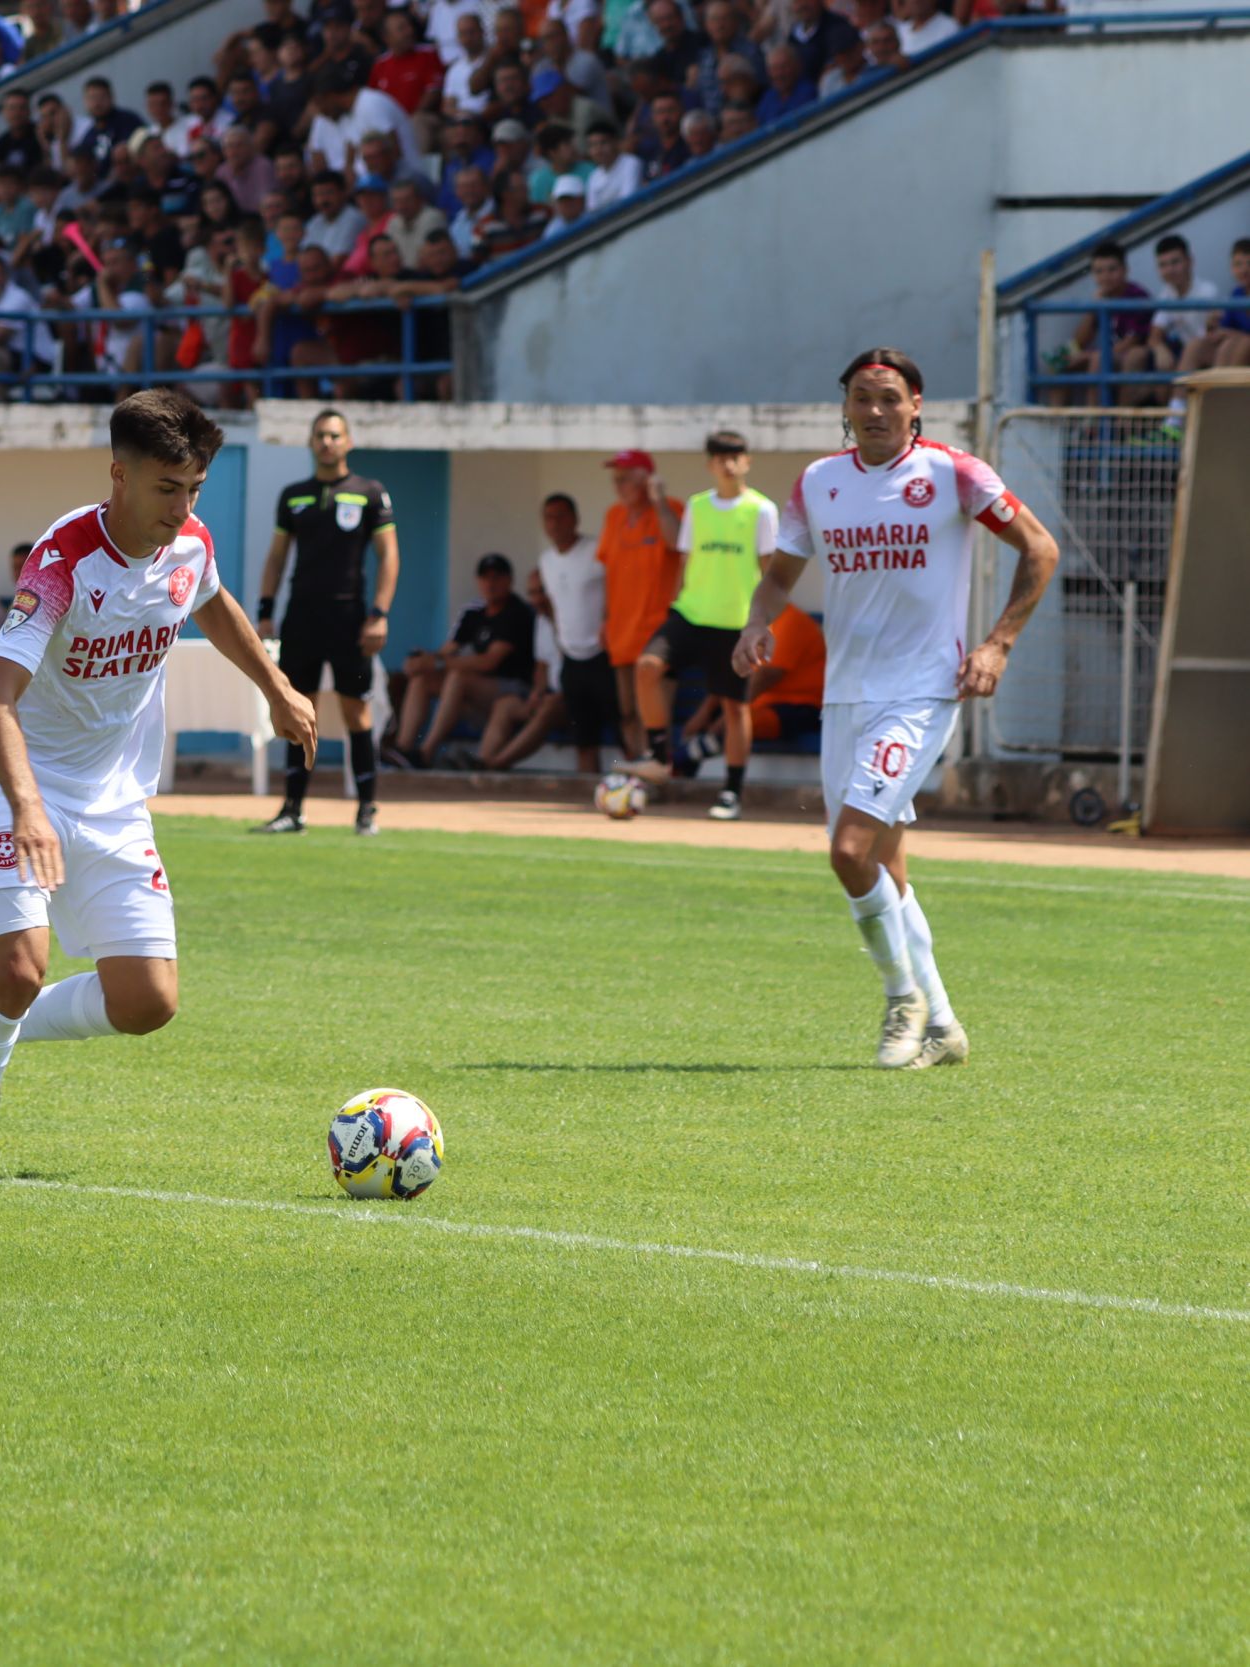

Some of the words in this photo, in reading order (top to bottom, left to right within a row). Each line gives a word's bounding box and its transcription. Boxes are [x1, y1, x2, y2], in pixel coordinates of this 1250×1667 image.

[992, 498, 1015, 522] C
[828, 549, 926, 573] SLATINA
[69, 617, 187, 659] PRIMĂRI
[873, 740, 906, 778] 10
[348, 1123, 369, 1158] Joma
